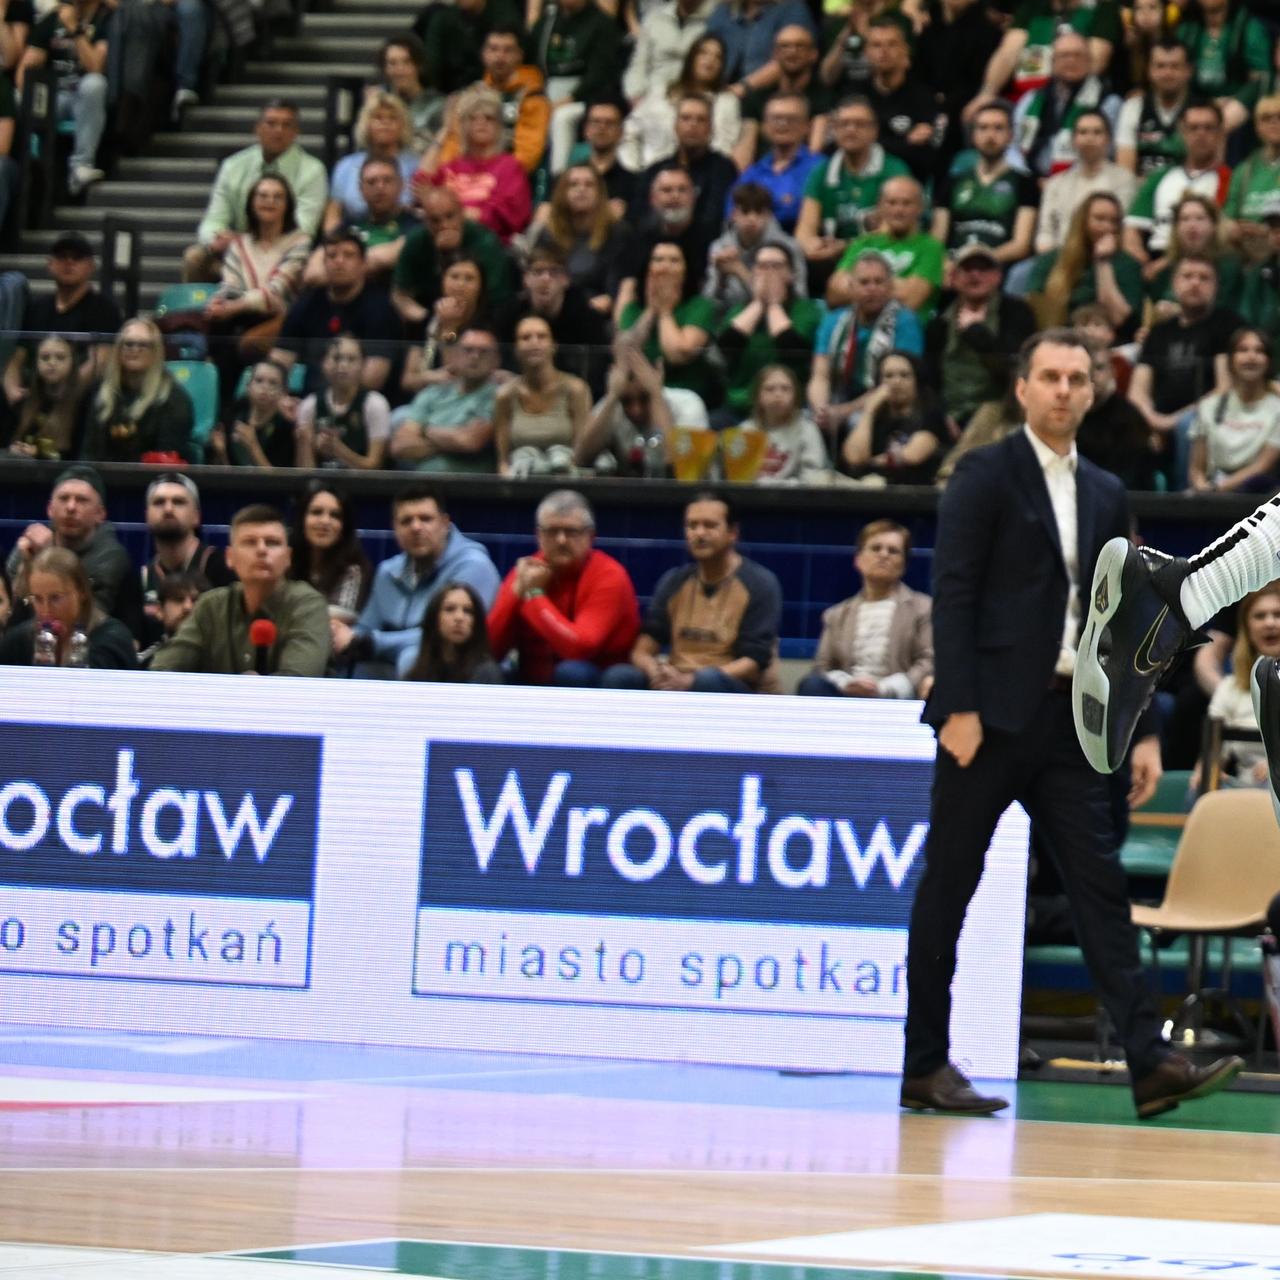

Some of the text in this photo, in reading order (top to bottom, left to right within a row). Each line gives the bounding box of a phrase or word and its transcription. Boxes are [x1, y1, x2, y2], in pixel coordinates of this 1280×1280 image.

[454, 767, 931, 890] Wrocław
[57, 910, 283, 967] spotkań
[444, 932, 646, 983] miasto
